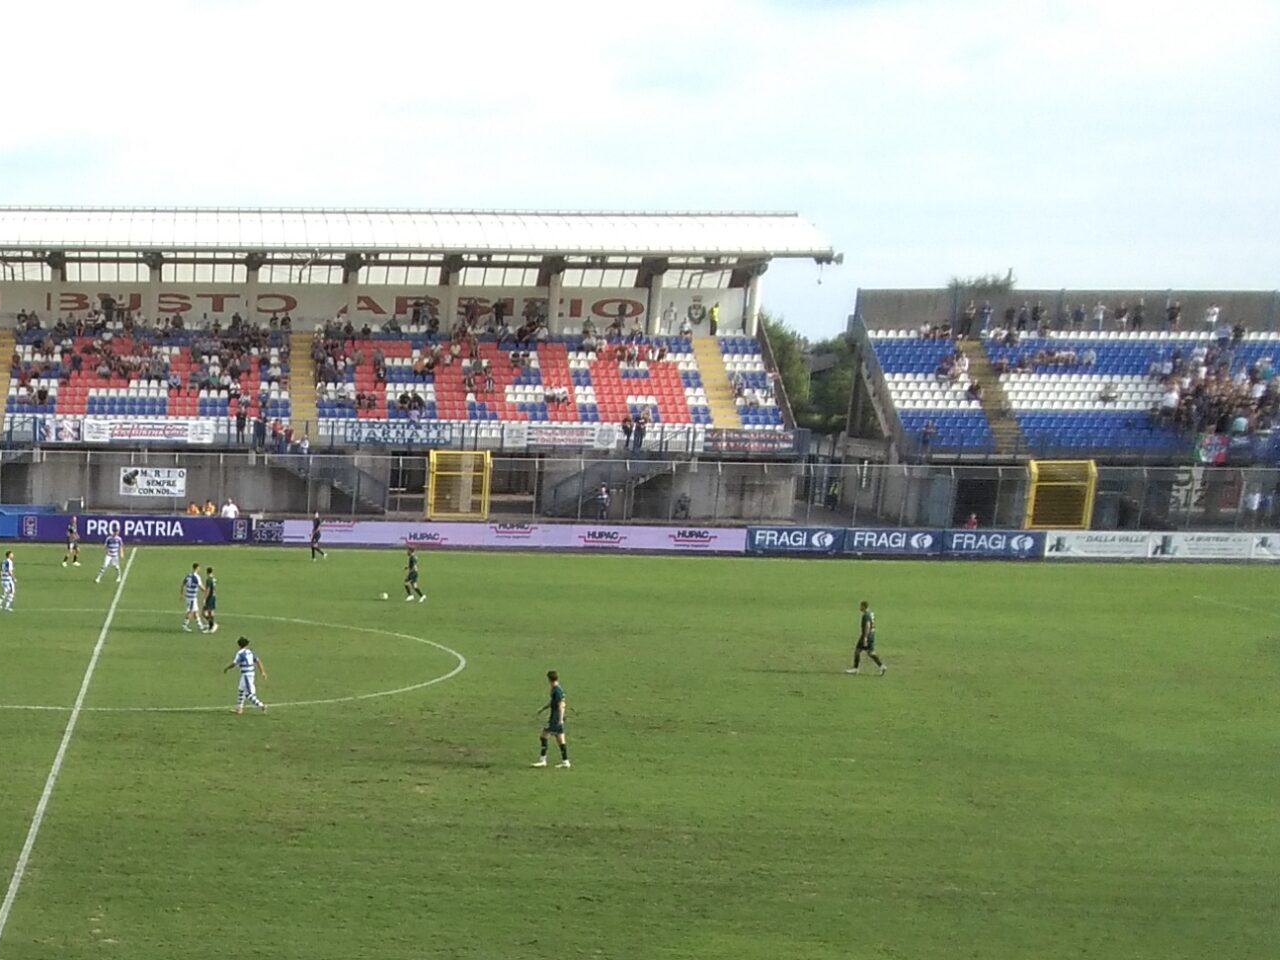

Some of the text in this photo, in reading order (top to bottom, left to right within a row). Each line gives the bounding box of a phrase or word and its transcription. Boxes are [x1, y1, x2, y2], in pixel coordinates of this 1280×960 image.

[137, 487, 154, 495] CON
[86, 519, 185, 538] PRO PATRIA
[408, 531, 441, 542] HUPAC
[586, 530, 619, 540] HUPAC
[677, 529, 709, 540] HUPAC
[755, 530, 807, 548] FRAGI
[853, 531, 907, 549] FRAGI
[1086, 535, 1117, 543] DALLA
[951, 532, 1006, 550] FRAGI
